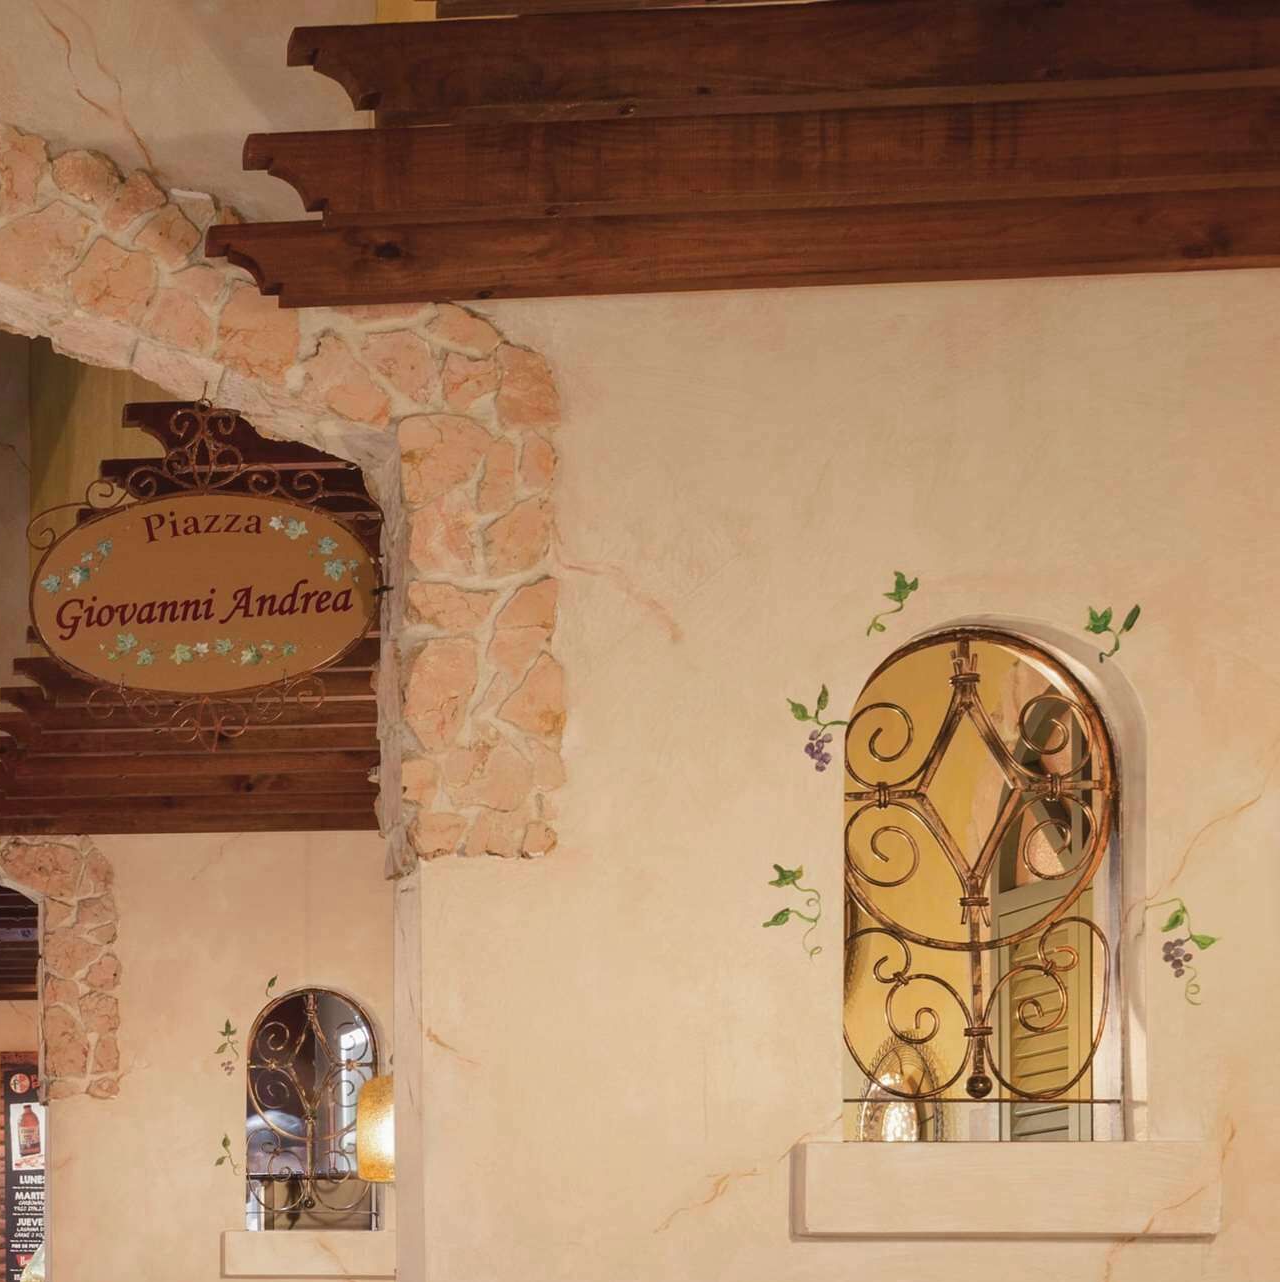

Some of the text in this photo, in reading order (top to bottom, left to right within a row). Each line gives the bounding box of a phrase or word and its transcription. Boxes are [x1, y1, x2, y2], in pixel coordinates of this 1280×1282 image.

[142, 511, 263, 544] Piazza
[55, 579, 354, 641] Giovanni Andrea
